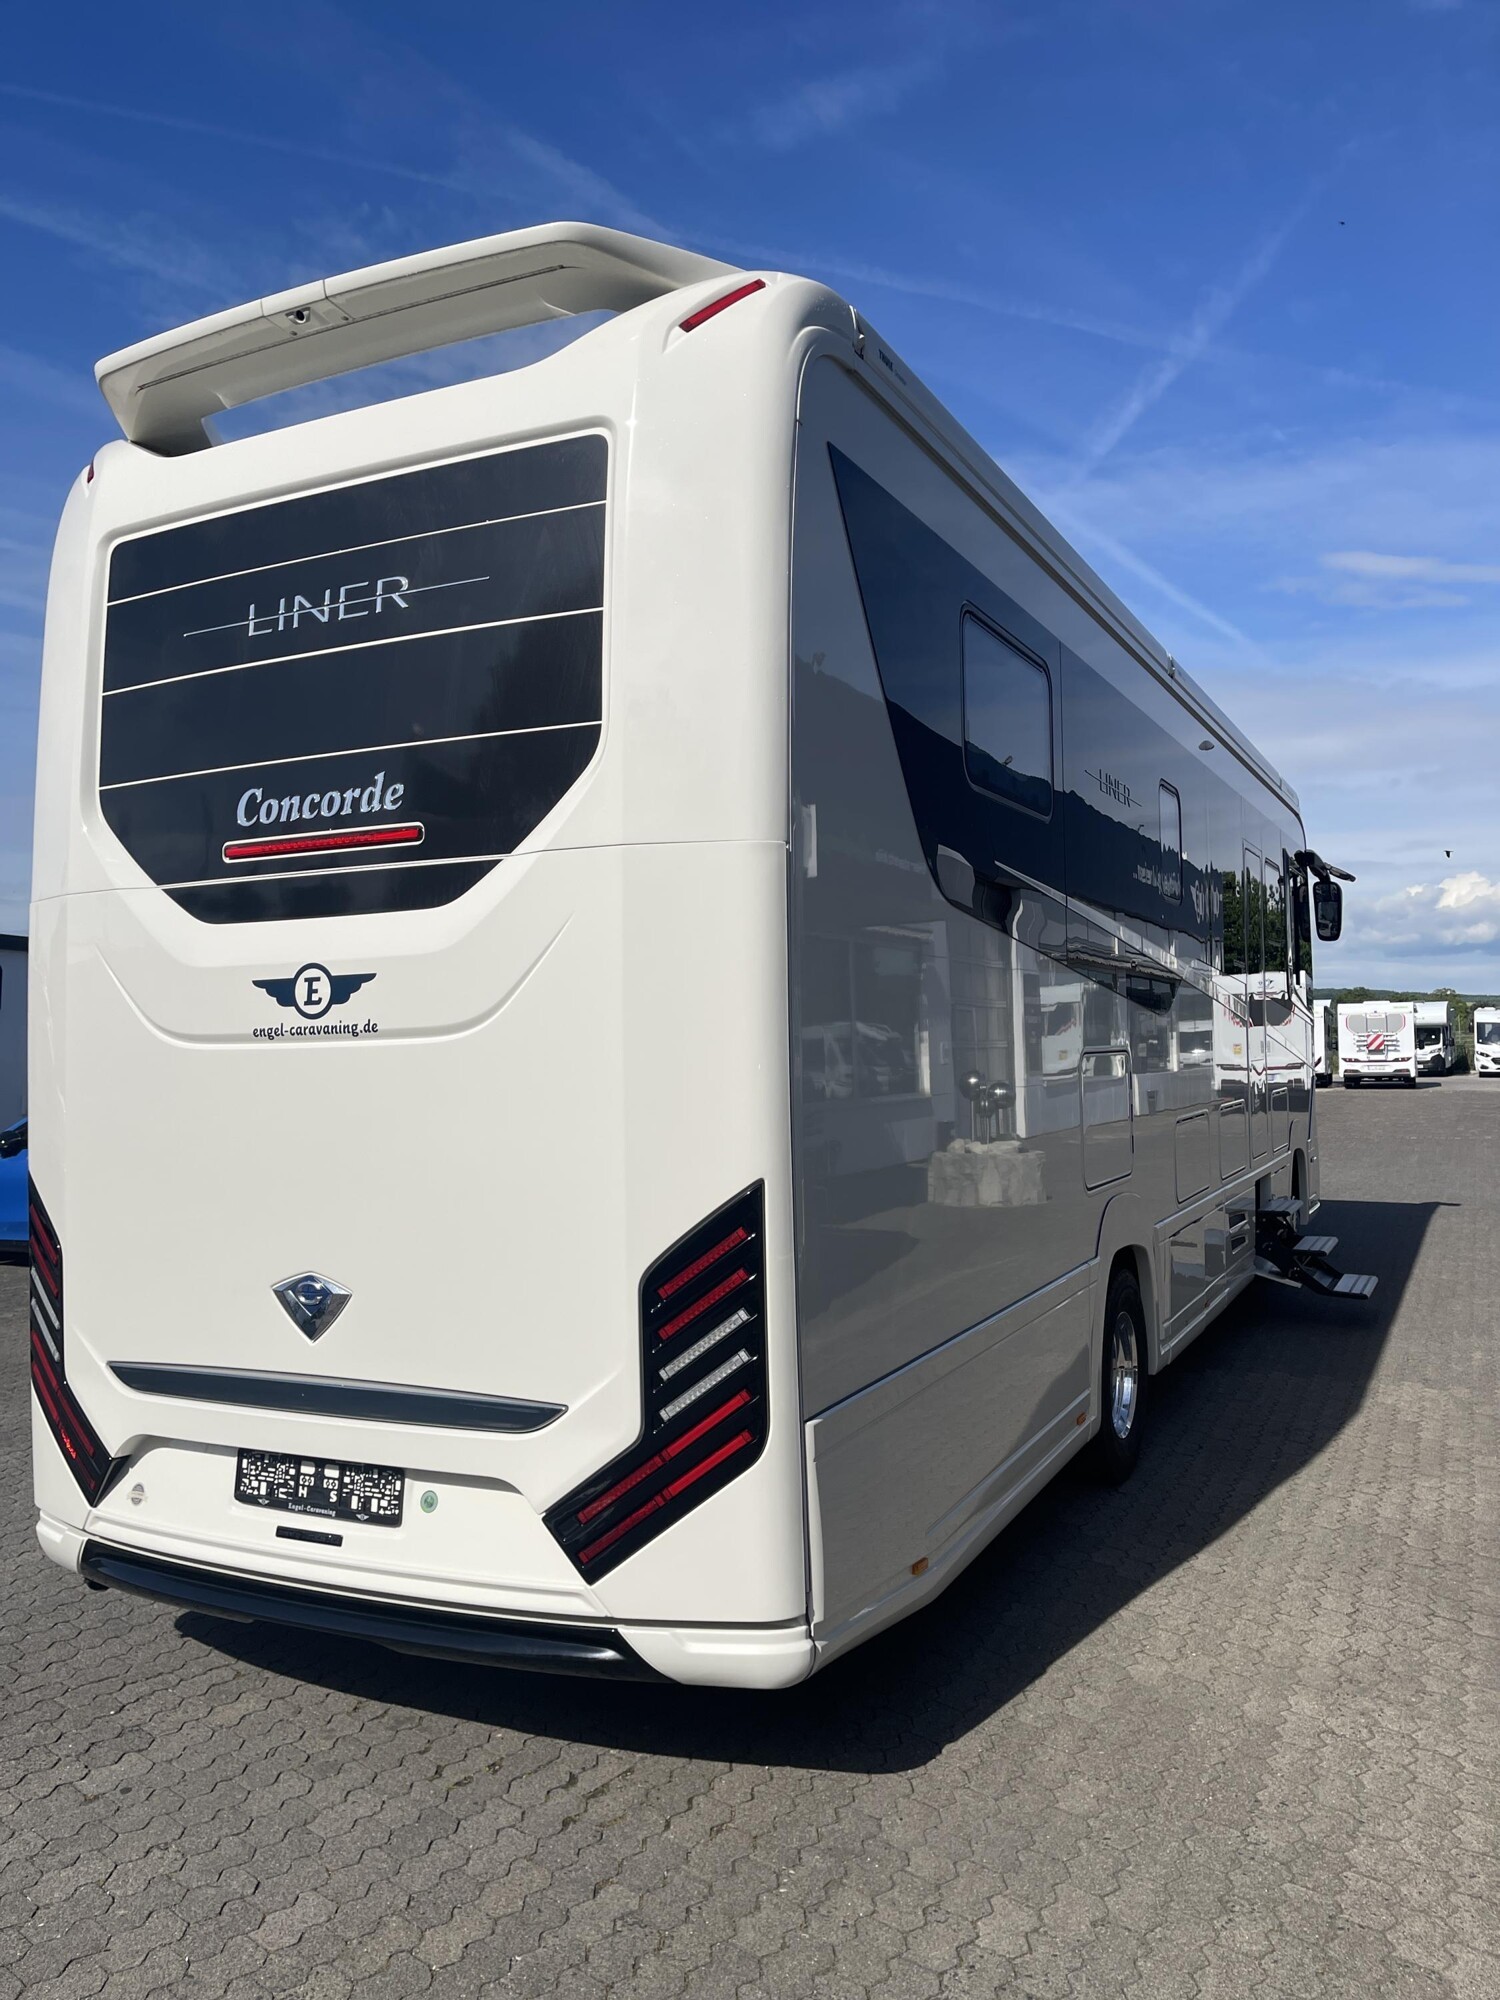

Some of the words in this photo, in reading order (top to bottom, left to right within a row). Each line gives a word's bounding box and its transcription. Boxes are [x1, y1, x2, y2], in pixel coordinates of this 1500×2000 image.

[247, 575, 409, 637] LINER
[237, 770, 405, 828] Concorde
[303, 976, 323, 1006] E
[252, 1018, 379, 1041] engel-caravaning.de
[287, 1502, 336, 1517] Engel-Caravaning
